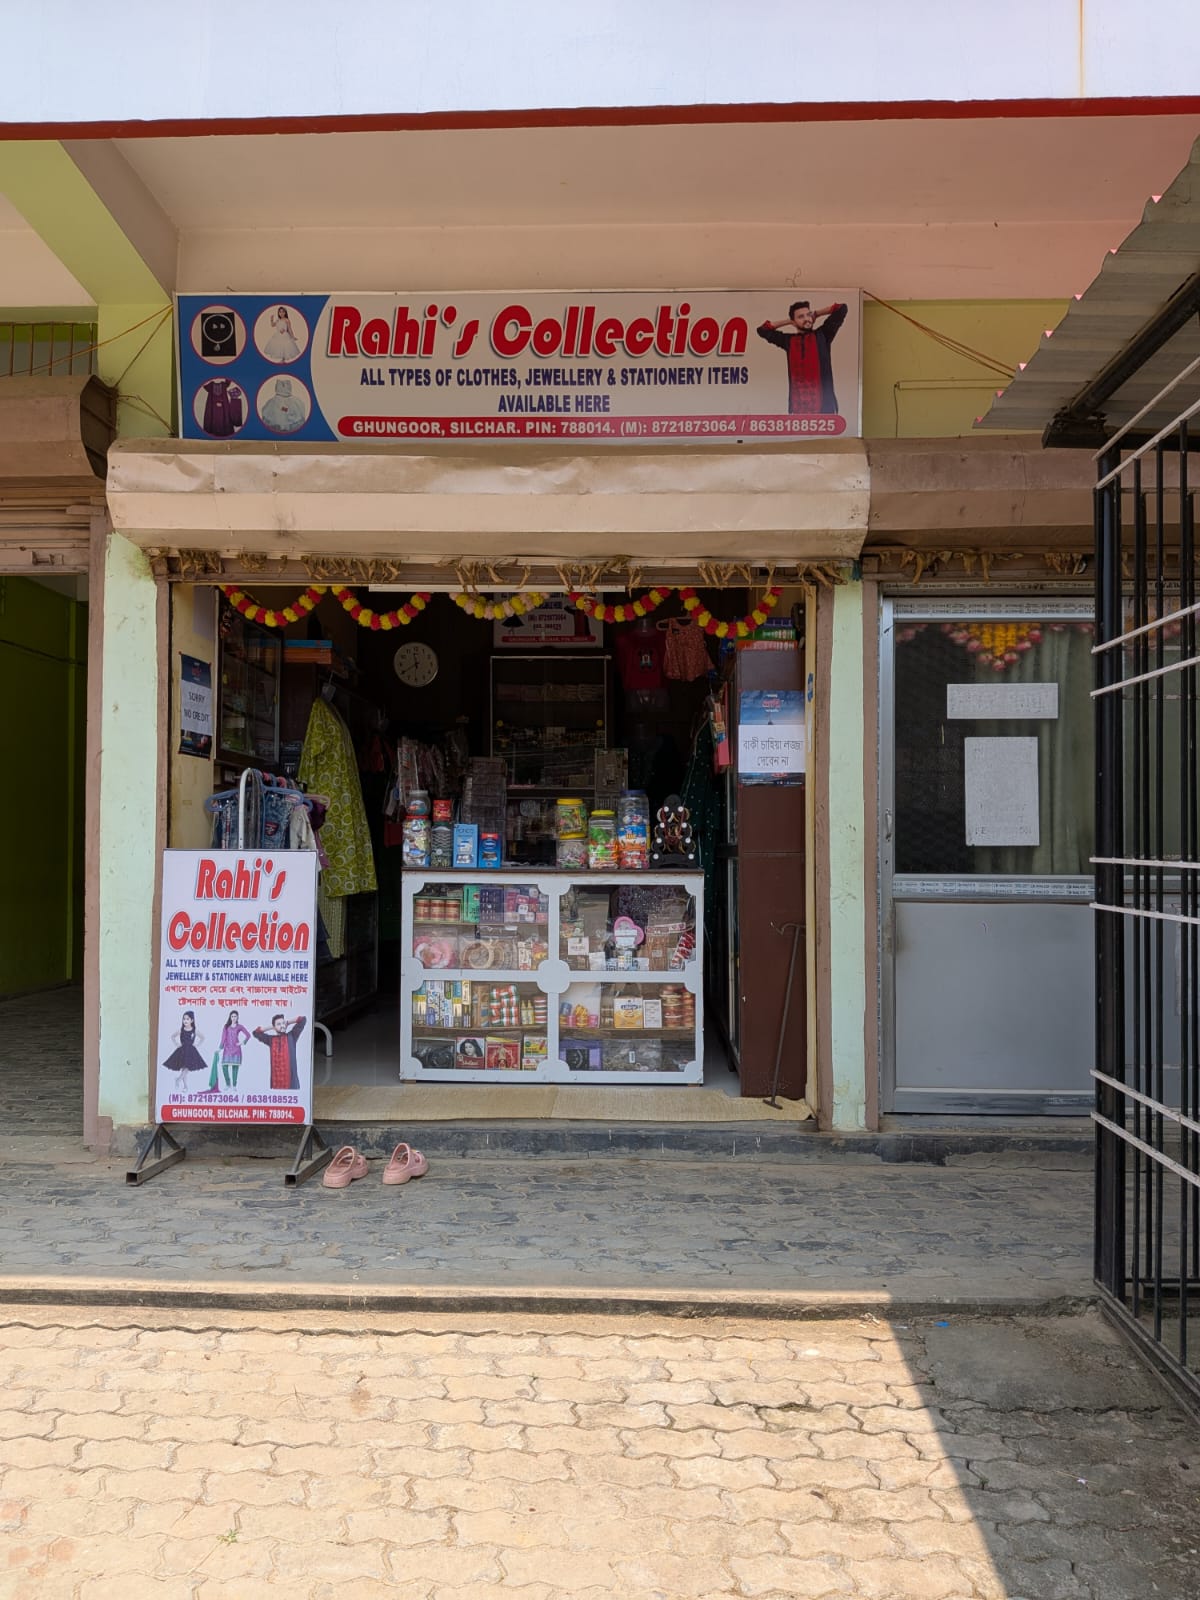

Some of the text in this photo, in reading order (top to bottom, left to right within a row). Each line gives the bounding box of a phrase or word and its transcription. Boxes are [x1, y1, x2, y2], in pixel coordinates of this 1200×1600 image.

[328, 302, 749, 358] Rahi's Collection
[360, 366, 749, 389] ALL TYPES OF CLOTHES, JEWELLERY & STATIONERY ITEMS
[498, 394, 610, 413] AVAILABLE HERE
[353, 421, 446, 436] GHUNGOOR,
[525, 421, 557, 435] PIN:
[620, 420, 648, 436] (M):
[652, 419, 737, 433] 8721873064
[740, 419, 746, 433] /
[749, 419, 836, 433] 8638188525
[188, 691, 206, 704] SORRY
[183, 708, 210, 724] NO CREDIT
[781, 755, 790, 767] না
[195, 857, 287, 901] Rahi's
[168, 910, 310, 953] Collection
[165, 959, 309, 970] ALL TYPES OF GENTS LADIES AND KIDS ITEM
[165, 972, 309, 983] JEWELLERY & STATIONERY AVAILABLE HERE
[168, 1094, 186, 1104] (M):
[187, 1094, 240, 1103] 8721873064
[246, 1095, 299, 1104] 8638188525
[171, 1108, 215, 1119] GHUNGOOR,
[252, 1109, 268, 1119] PIN:
